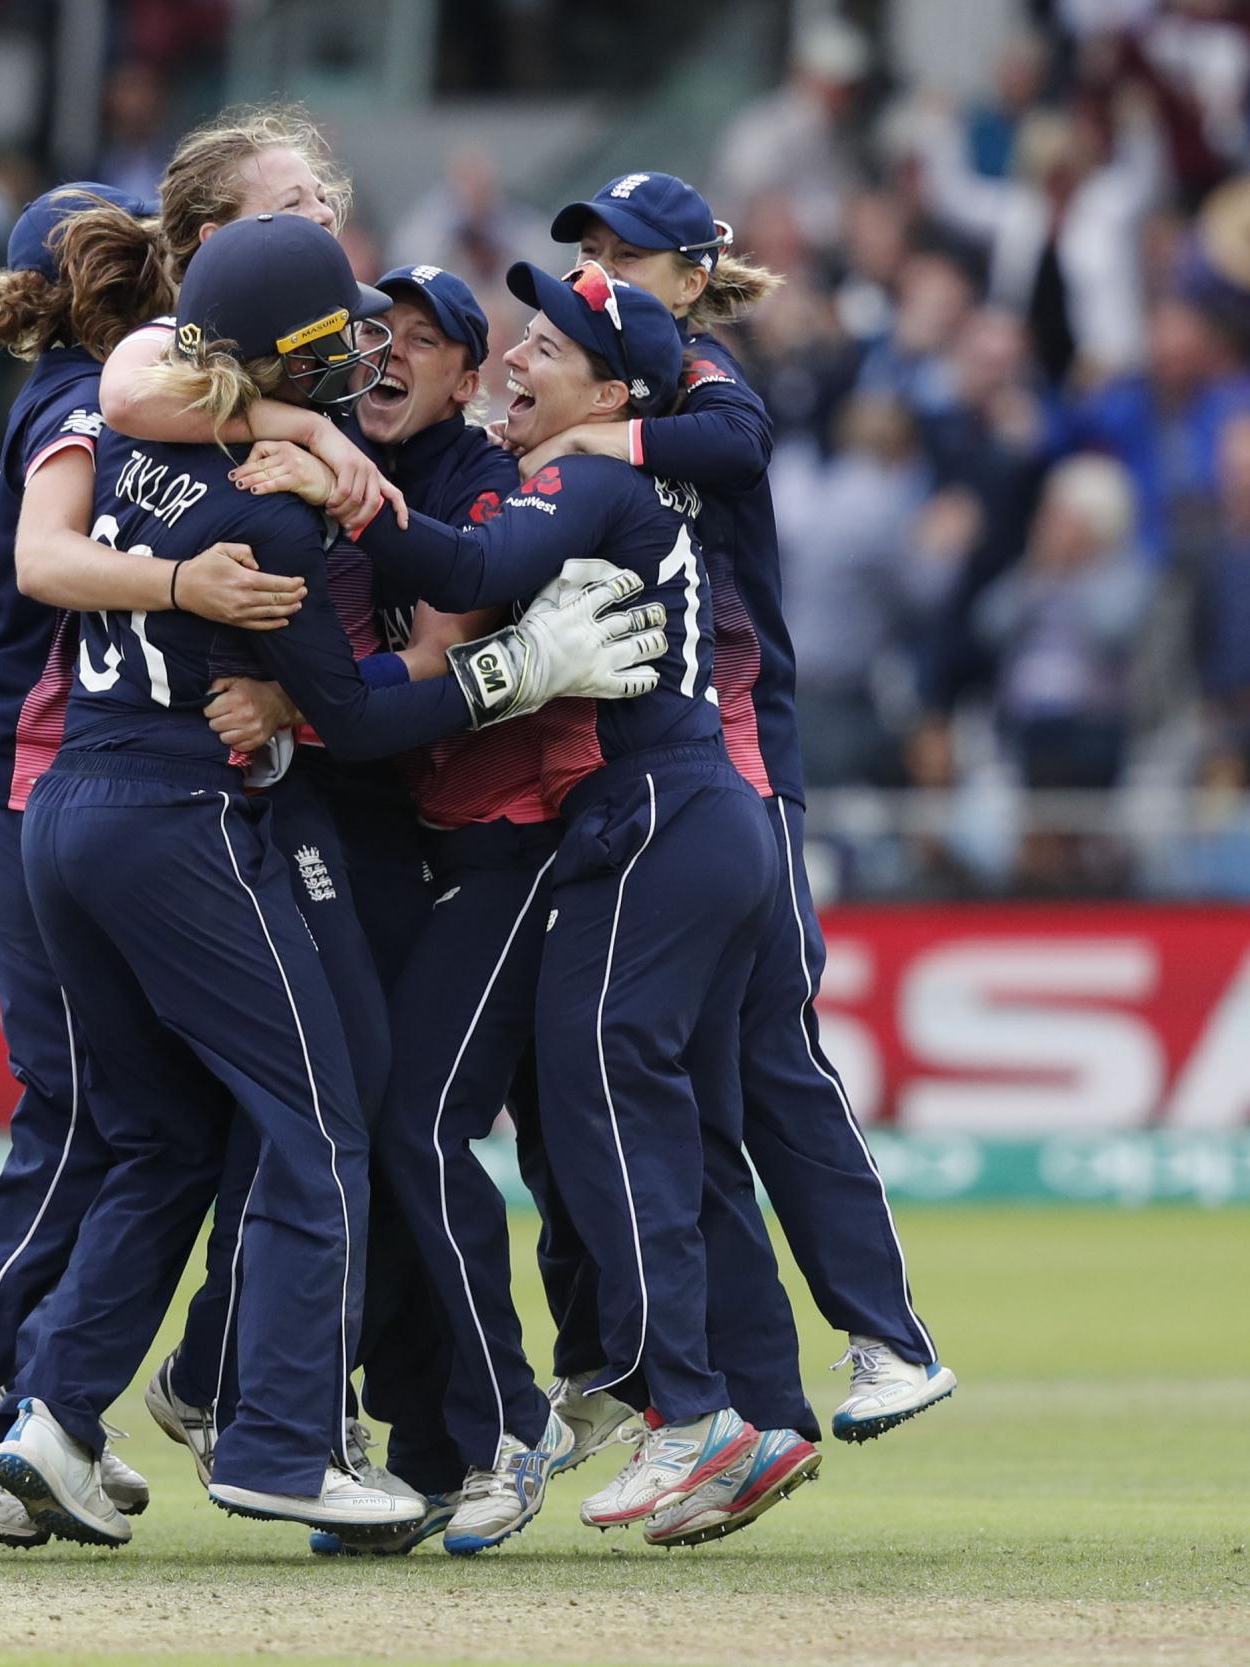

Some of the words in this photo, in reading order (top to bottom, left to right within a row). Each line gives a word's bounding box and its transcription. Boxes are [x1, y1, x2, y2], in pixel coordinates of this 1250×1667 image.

[301, 316, 338, 339] MASURI
[114, 450, 208, 529] TAYLOR
[506, 496, 557, 515] NatWest
[476, 653, 507, 693] GM
